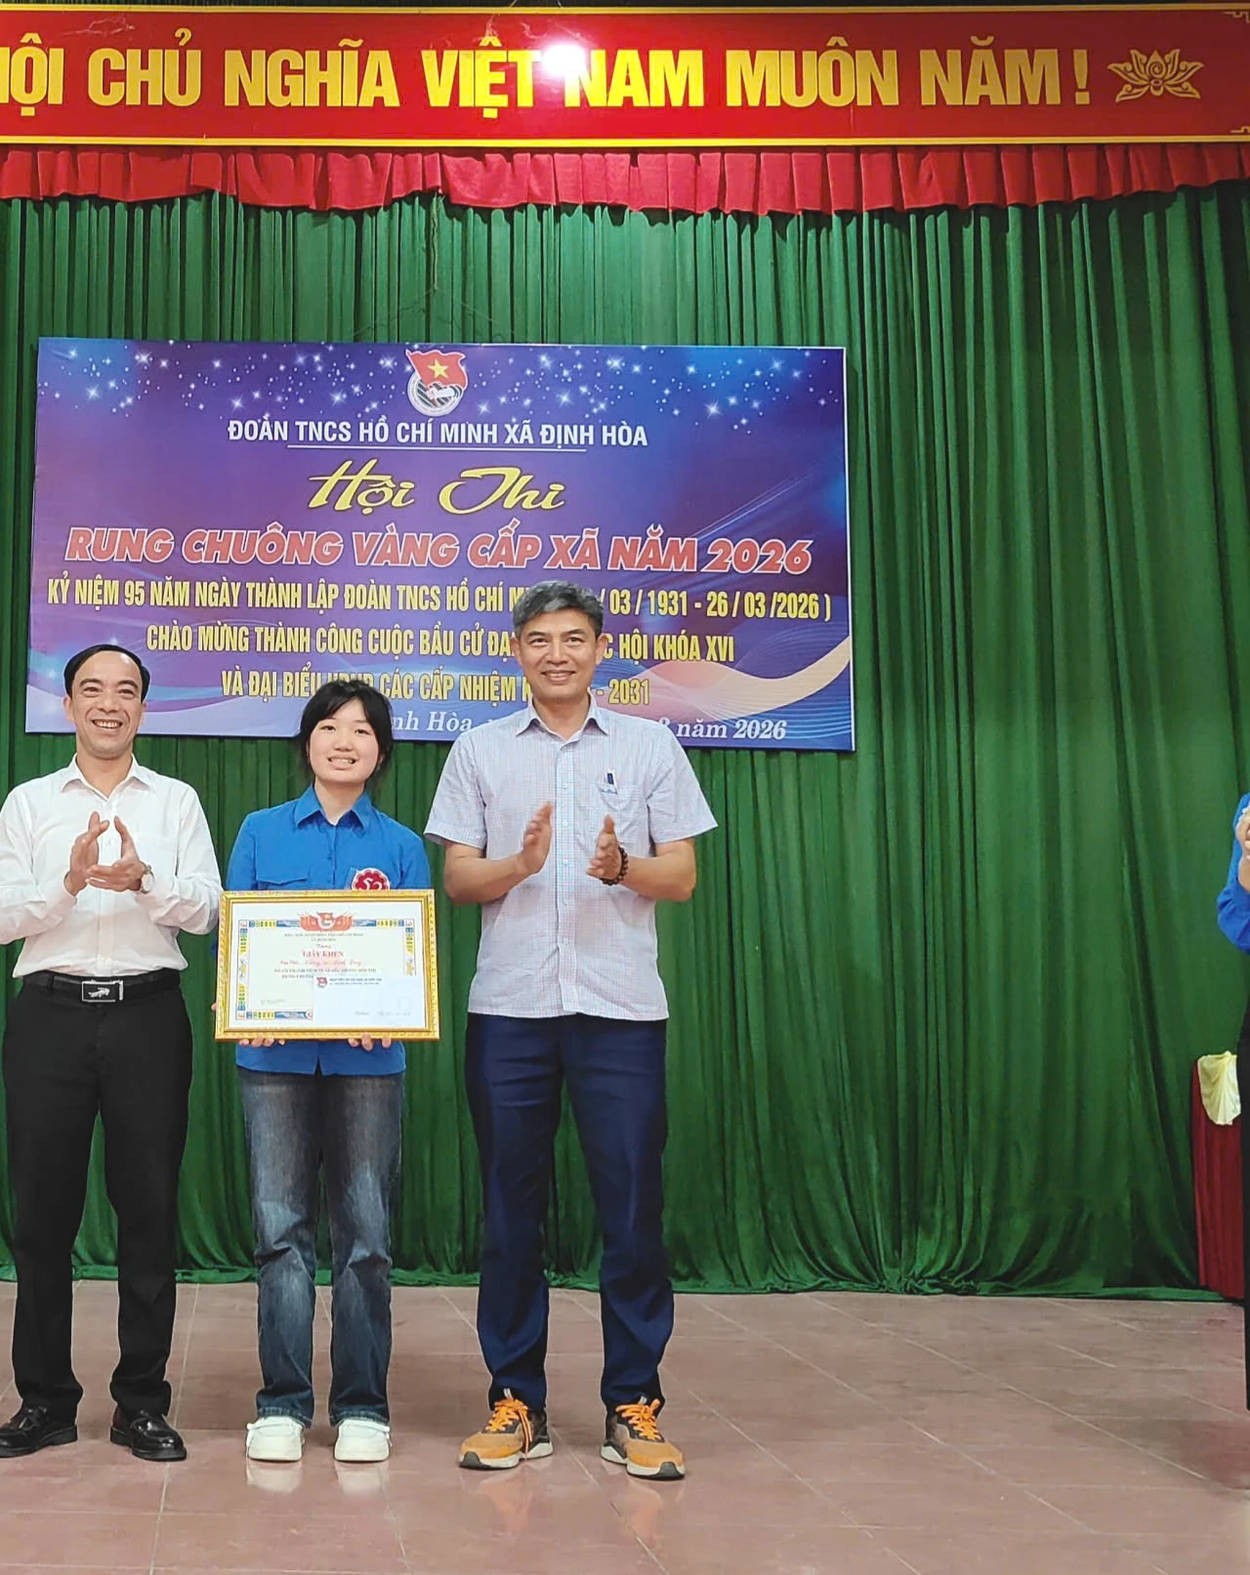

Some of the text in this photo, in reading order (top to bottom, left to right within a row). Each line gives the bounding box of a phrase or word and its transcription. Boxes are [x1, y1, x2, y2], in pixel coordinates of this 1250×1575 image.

[88, 28, 202, 107] CHỦ
[224, 38, 400, 108] NGHĨA
[421, 36, 542, 119] VIỆT
[564, 49, 705, 107] NAM
[725, 36, 899, 108] MUÔN
[919, 35, 1061, 106] NĂM
[228, 414, 649, 450] ĐOÀN TNCS HỒ CHÍ MINH XÃ ĐỊNH HÒA
[308, 458, 566, 516] Hội Thi
[64, 517, 814, 575] RUNG CHUÔNG VÀNG CẤP XÃ NĂM 2026
[47, 571, 71, 605] KỶ
[74, 574, 120, 611] NIỆM
[124, 580, 146, 606] 95
[150, 576, 191, 607] NĂM
[194, 576, 242, 608] NGÀY
[246, 577, 302, 609] THÀNH
[306, 577, 340, 615] LẬP
[343, 579, 392, 610] ĐOÀN
[396, 584, 442, 611] TNCS
[445, 577, 470, 612] HỒ
[474, 581, 504, 612] CHÍ
[609, 589, 632, 615] 03
[647, 590, 689, 617] 1931
[706, 590, 729, 618] 26
[744, 591, 766, 618] 03
[146, 619, 192, 651] CHÀO
[198, 620, 250, 652] MỪNG
[254, 621, 311, 653] THÀNH
[315, 622, 363, 654] CÔNG
[368, 623, 415, 661] CUỘC
[419, 620, 454, 656] BẦU
[459, 621, 485, 657] CỬ
[618, 627, 649, 666] HỘI
[653, 629, 702, 662] KHÓA
[706, 635, 735, 662] XVI
[221, 665, 245, 697] VÀ
[248, 670, 278, 703] ĐẠI
[282, 661, 323, 698] BIỂU
[378, 668, 415, 700] CÁC
[419, 665, 455, 701] CẤP
[459, 669, 517, 707] NHIỆM
[608, 679, 650, 705] 2031
[391, 710, 419, 731] nh
[676, 718, 728, 739] năm
[732, 718, 788, 740] 2026
